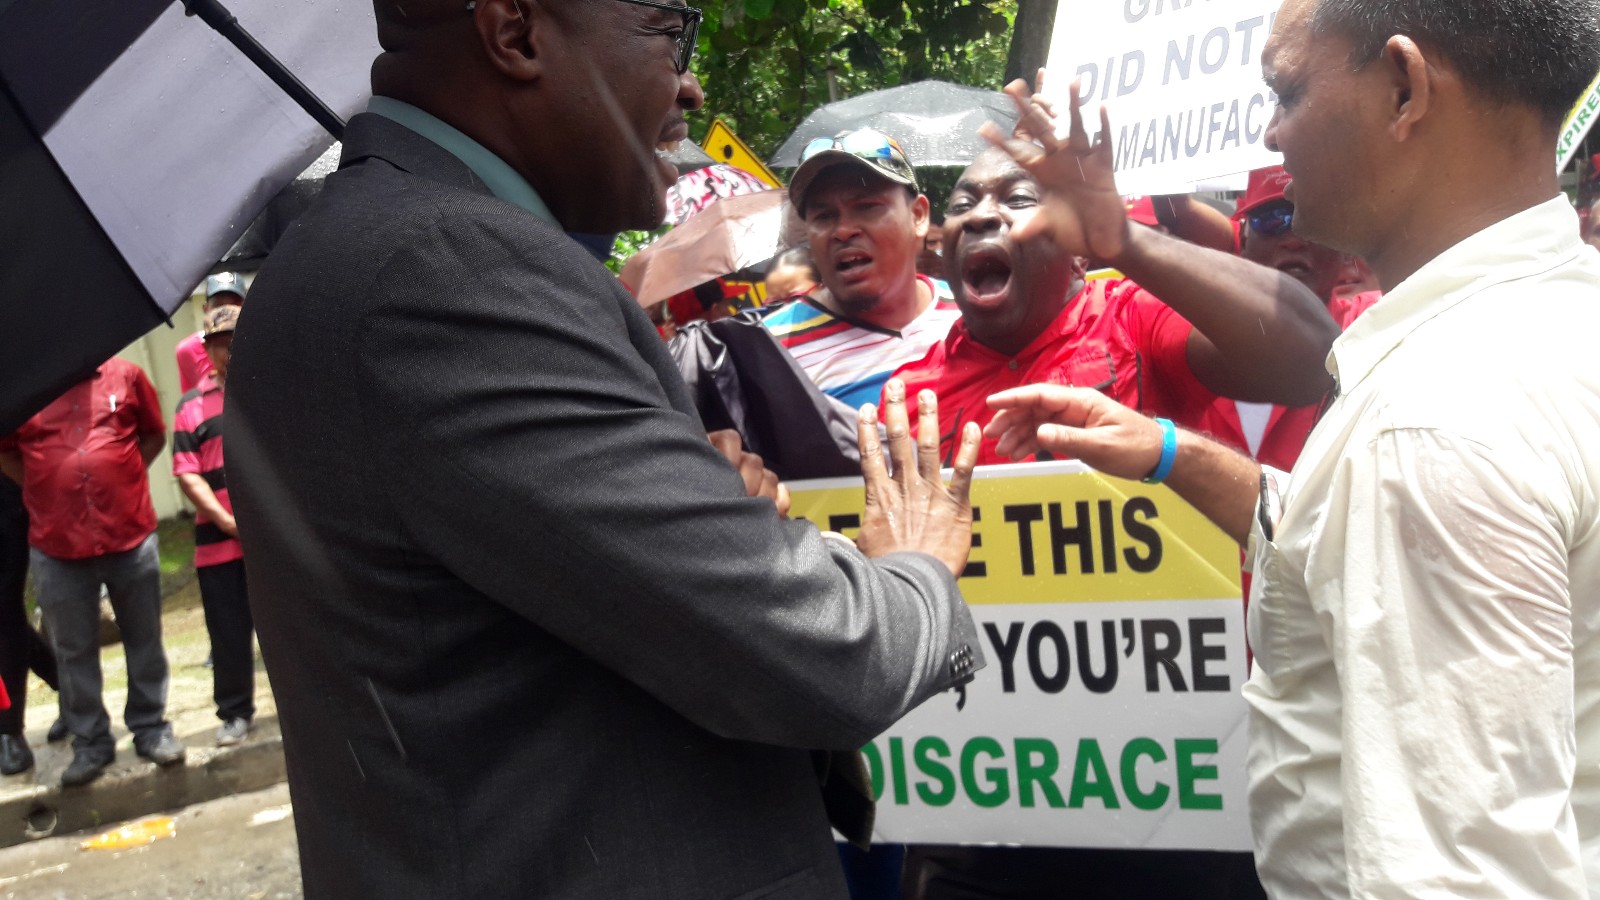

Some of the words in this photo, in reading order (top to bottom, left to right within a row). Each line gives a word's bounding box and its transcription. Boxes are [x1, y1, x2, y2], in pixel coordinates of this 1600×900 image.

[1076, 50, 1145, 106] DID
[1004, 496, 1163, 576] THIS
[983, 617, 1231, 694] YOU'RE
